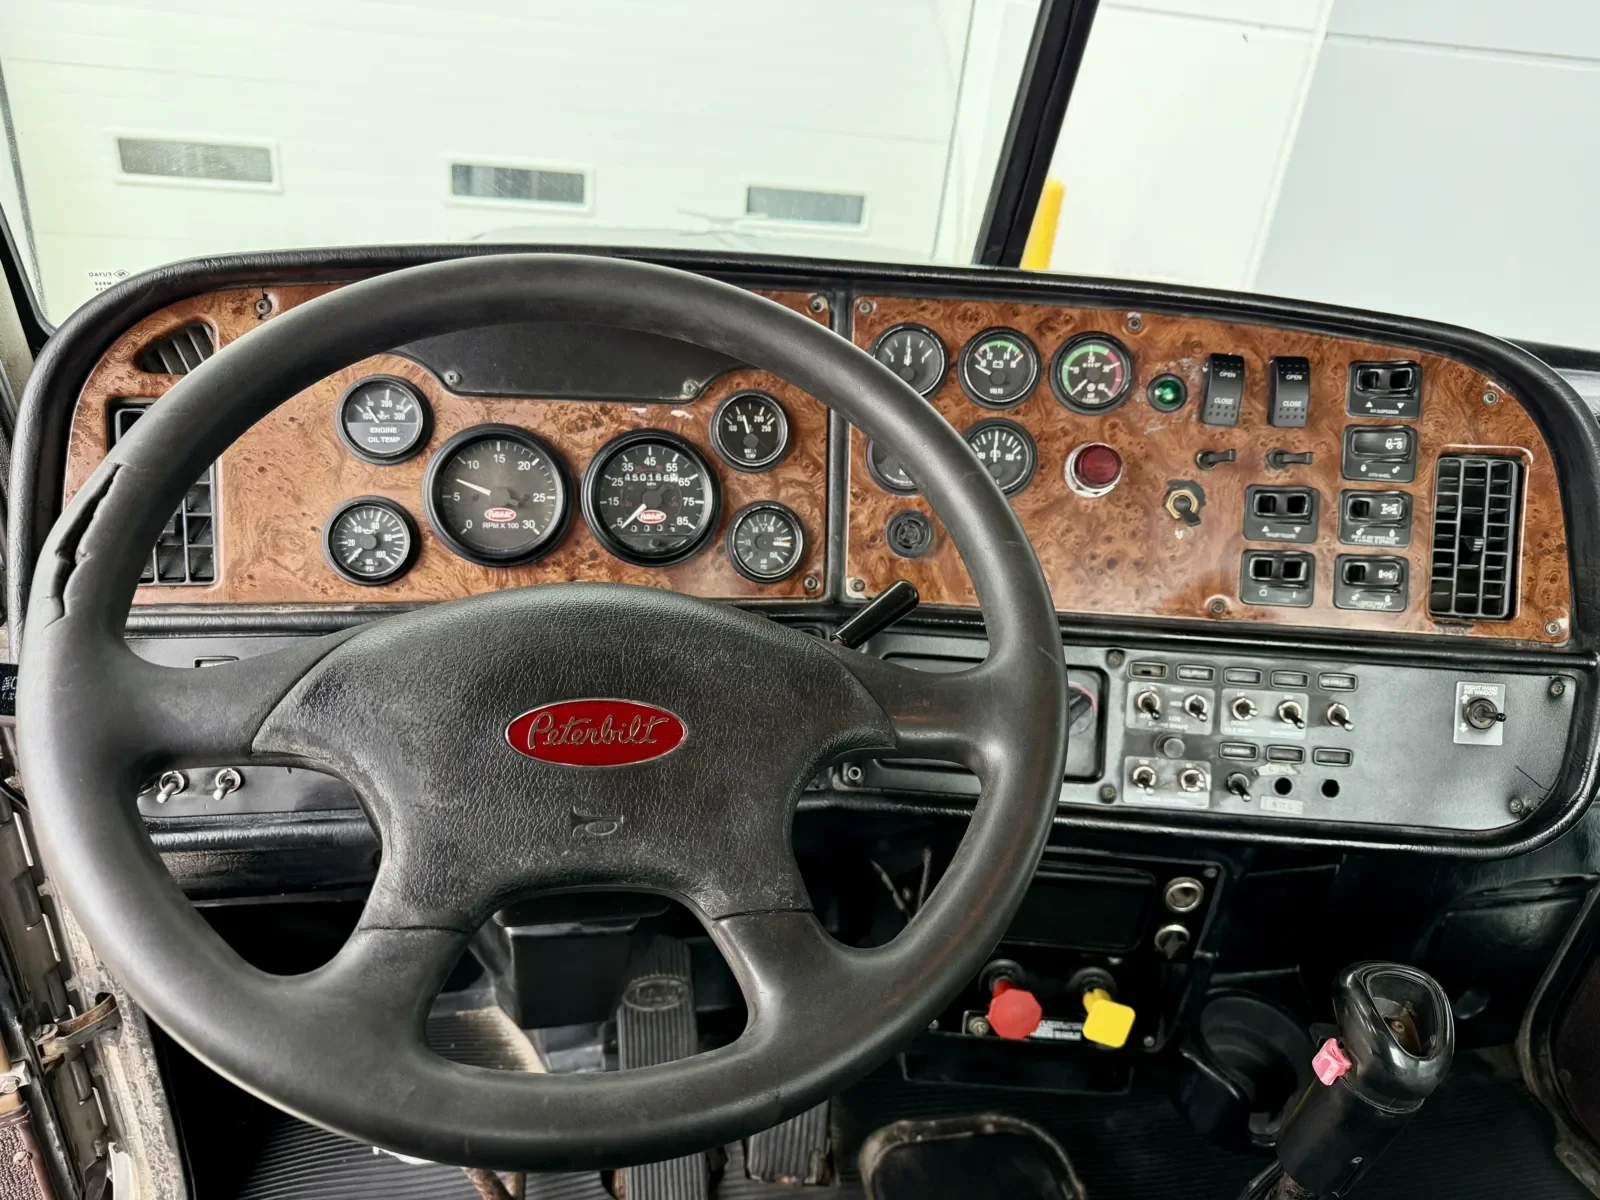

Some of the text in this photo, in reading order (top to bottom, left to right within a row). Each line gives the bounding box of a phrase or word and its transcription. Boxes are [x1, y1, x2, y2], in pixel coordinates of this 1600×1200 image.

[380, 400, 392, 408] 200
[394, 412, 406, 420] 300
[762, 424, 772, 432] 250
[494, 454, 506, 463] 15
[644, 457, 656, 466] 45
[467, 460, 480, 470] 10
[518, 461, 530, 470] 20
[622, 462, 634, 472] 35
[666, 463, 678, 472] 55
[612, 478, 624, 486] 25
[678, 478, 690, 486] 65
[453, 492, 460, 501] 5
[532, 492, 546, 502] 25
[608, 497, 620, 506] 15
[682, 497, 694, 506] 75
[466, 520, 472, 528] 0
[522, 520, 536, 529] 30
[616, 518, 624, 526] 5
[676, 517, 688, 526] 85
[352, 526, 362, 534] 40
[348, 538, 356, 546] 20
[528, 712, 669, 750] Peterbilt
